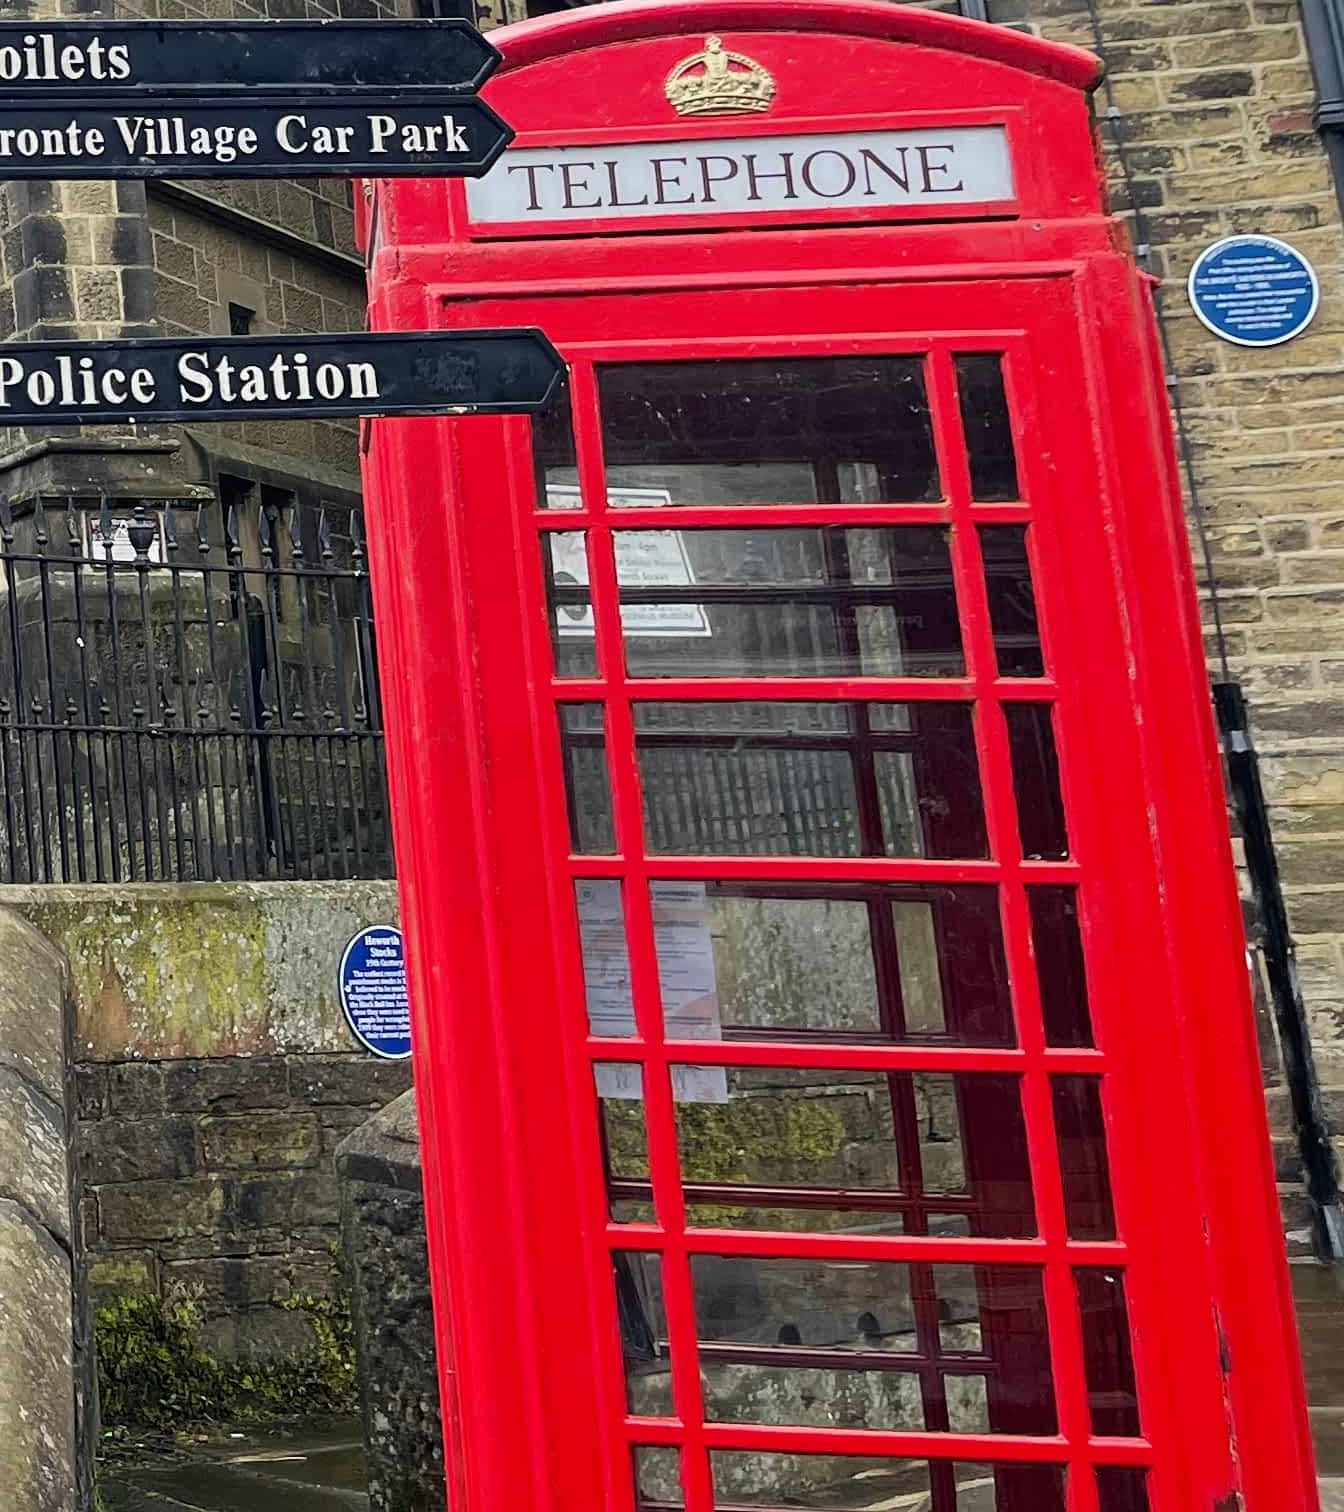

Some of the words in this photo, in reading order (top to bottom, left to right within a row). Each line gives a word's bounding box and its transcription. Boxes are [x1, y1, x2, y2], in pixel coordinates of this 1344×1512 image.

[113, 116, 258, 162] Village
[276, 114, 355, 154] Car
[367, 115, 471, 153] Park
[507, 144, 964, 211] TELEPHONE
[177, 352, 380, 404] Station
[365, 936, 400, 946] Haworth
[370, 948, 397, 957] Stocks
